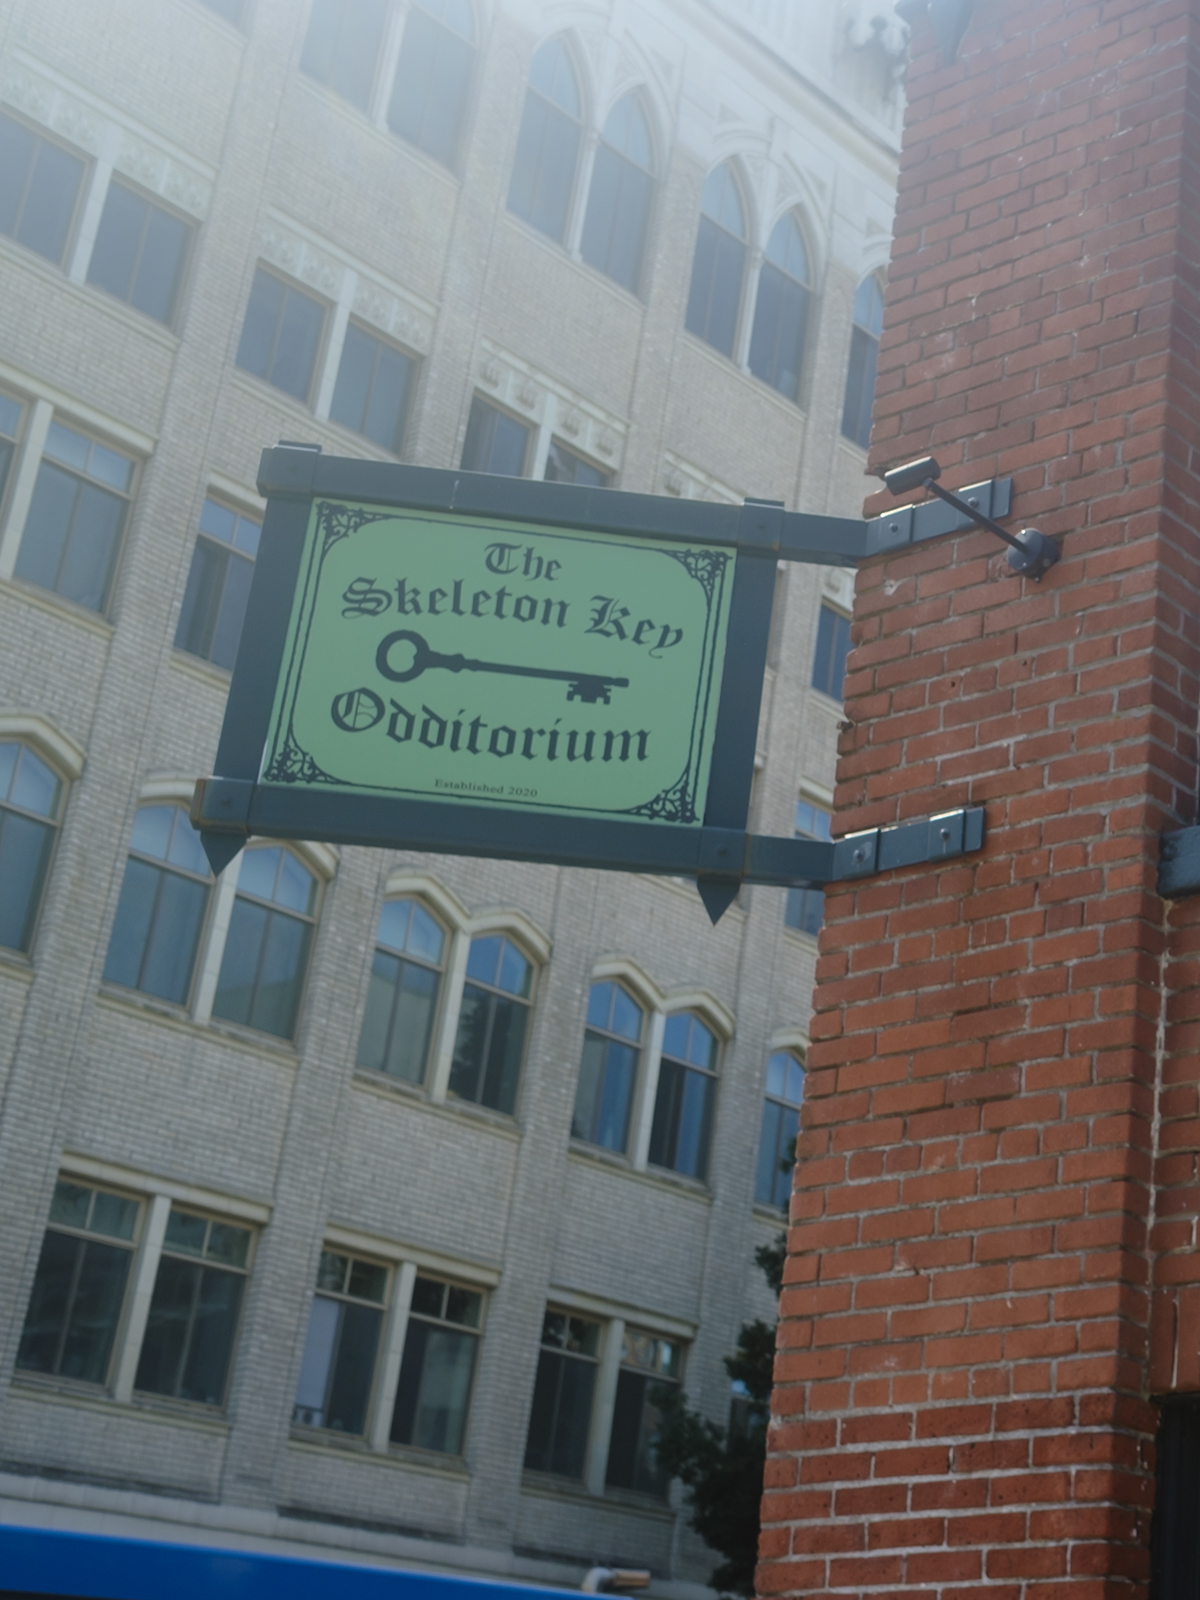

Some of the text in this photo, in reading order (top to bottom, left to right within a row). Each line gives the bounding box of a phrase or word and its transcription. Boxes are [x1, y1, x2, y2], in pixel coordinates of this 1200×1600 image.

[483, 541, 563, 582] The
[340, 576, 684, 659] Skeleton Key
[330, 686, 652, 763] Odditorium
[434, 779, 538, 797] Established 2020
